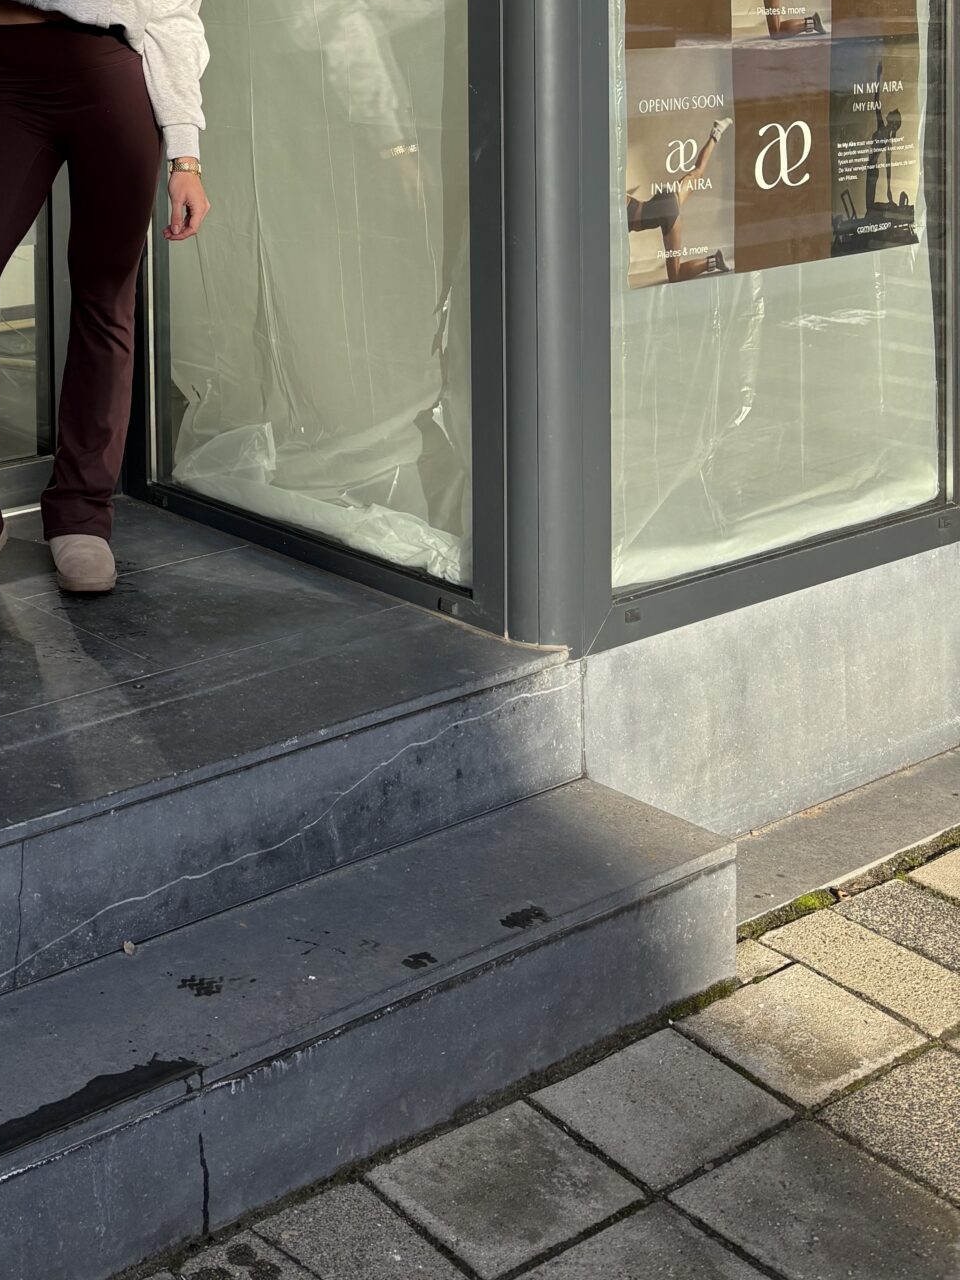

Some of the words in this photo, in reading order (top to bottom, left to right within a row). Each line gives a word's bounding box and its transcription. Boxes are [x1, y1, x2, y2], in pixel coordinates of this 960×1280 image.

[756, 6, 780, 17] Pilates
[781, 6, 786, 15] &
[853, 82, 863, 95] IN
[866, 82, 879, 95] MY
[882, 80, 904, 93] AIRA
[639, 96, 690, 114] OPENING
[692, 94, 725, 109] SOON
[852, 101, 867, 113] (MY
[867, 100, 882, 112] ERA)
[651, 182, 663, 196] IN
[666, 180, 683, 194] MY
[686, 177, 713, 192] AIRA
[856, 223, 878, 234] coming
[657, 246, 681, 259] Pilates
[682, 247, 688, 257] &
[690, 246, 708, 256] more
